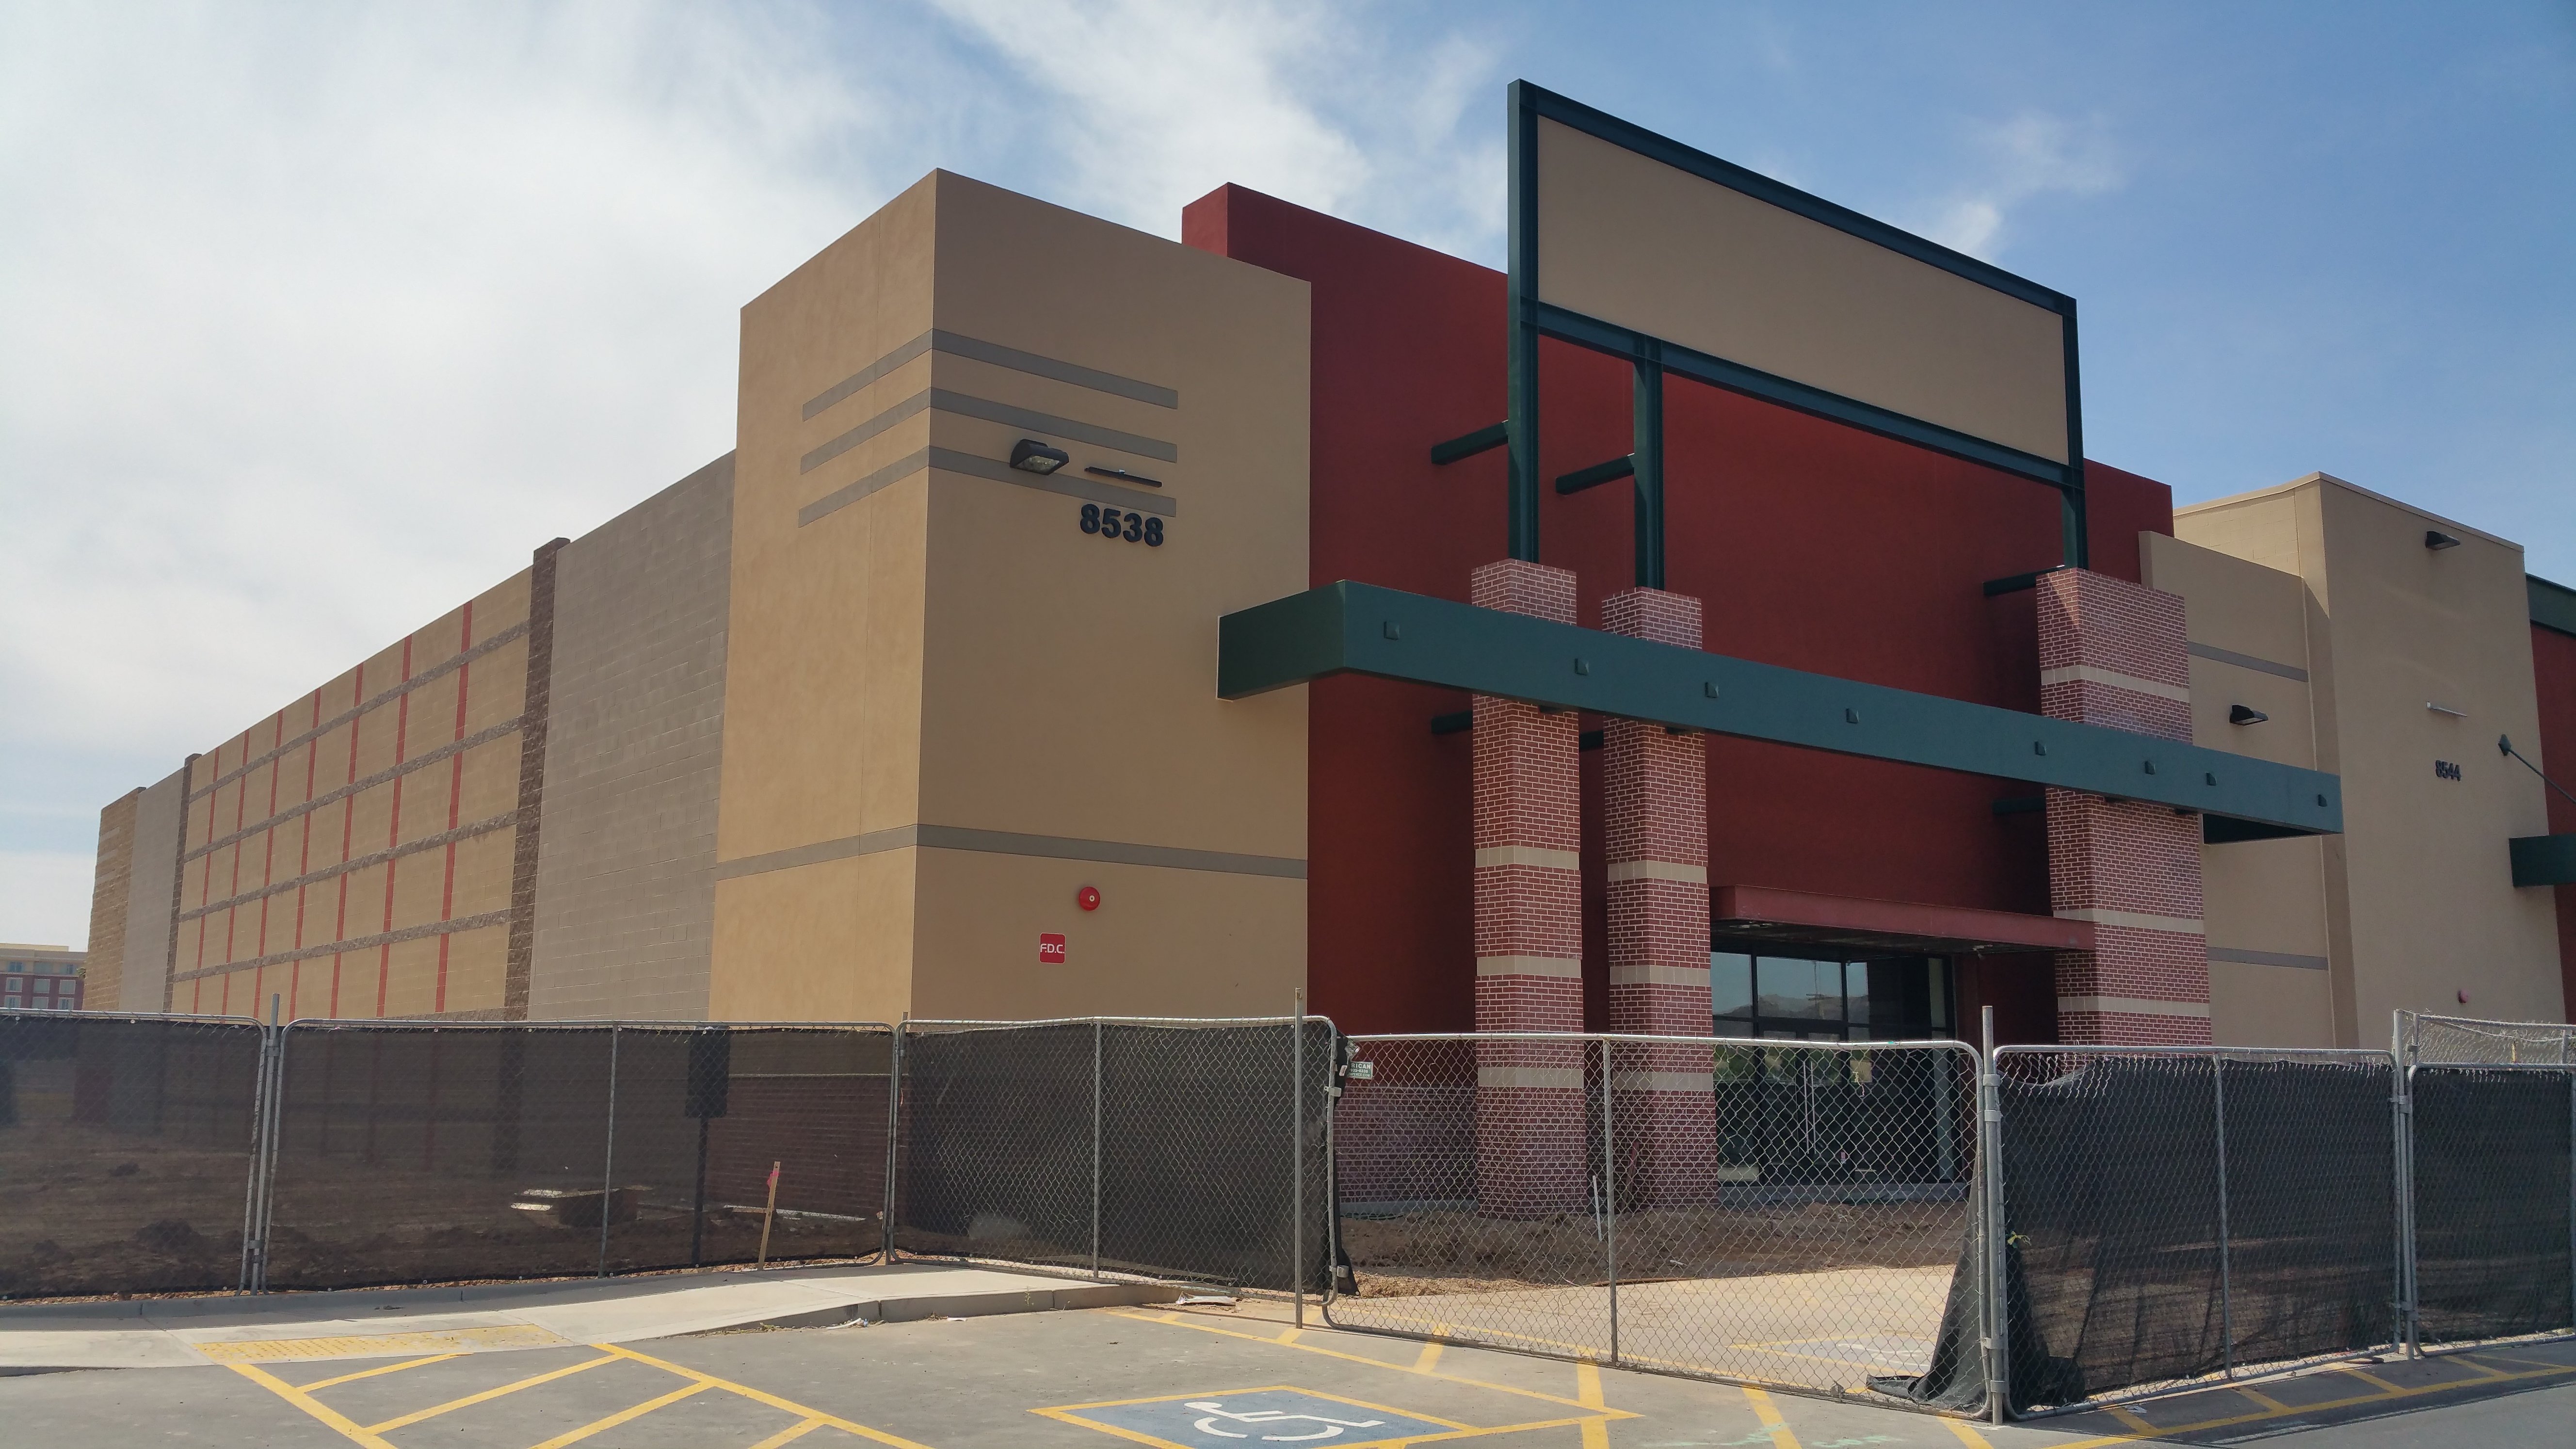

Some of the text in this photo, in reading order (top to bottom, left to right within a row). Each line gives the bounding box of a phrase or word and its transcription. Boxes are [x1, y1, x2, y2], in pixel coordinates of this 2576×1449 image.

[1080, 503, 1164, 547] 8538
[2435, 760, 2462, 781] 8544
[1040, 943, 1065, 954] F.D.C.
